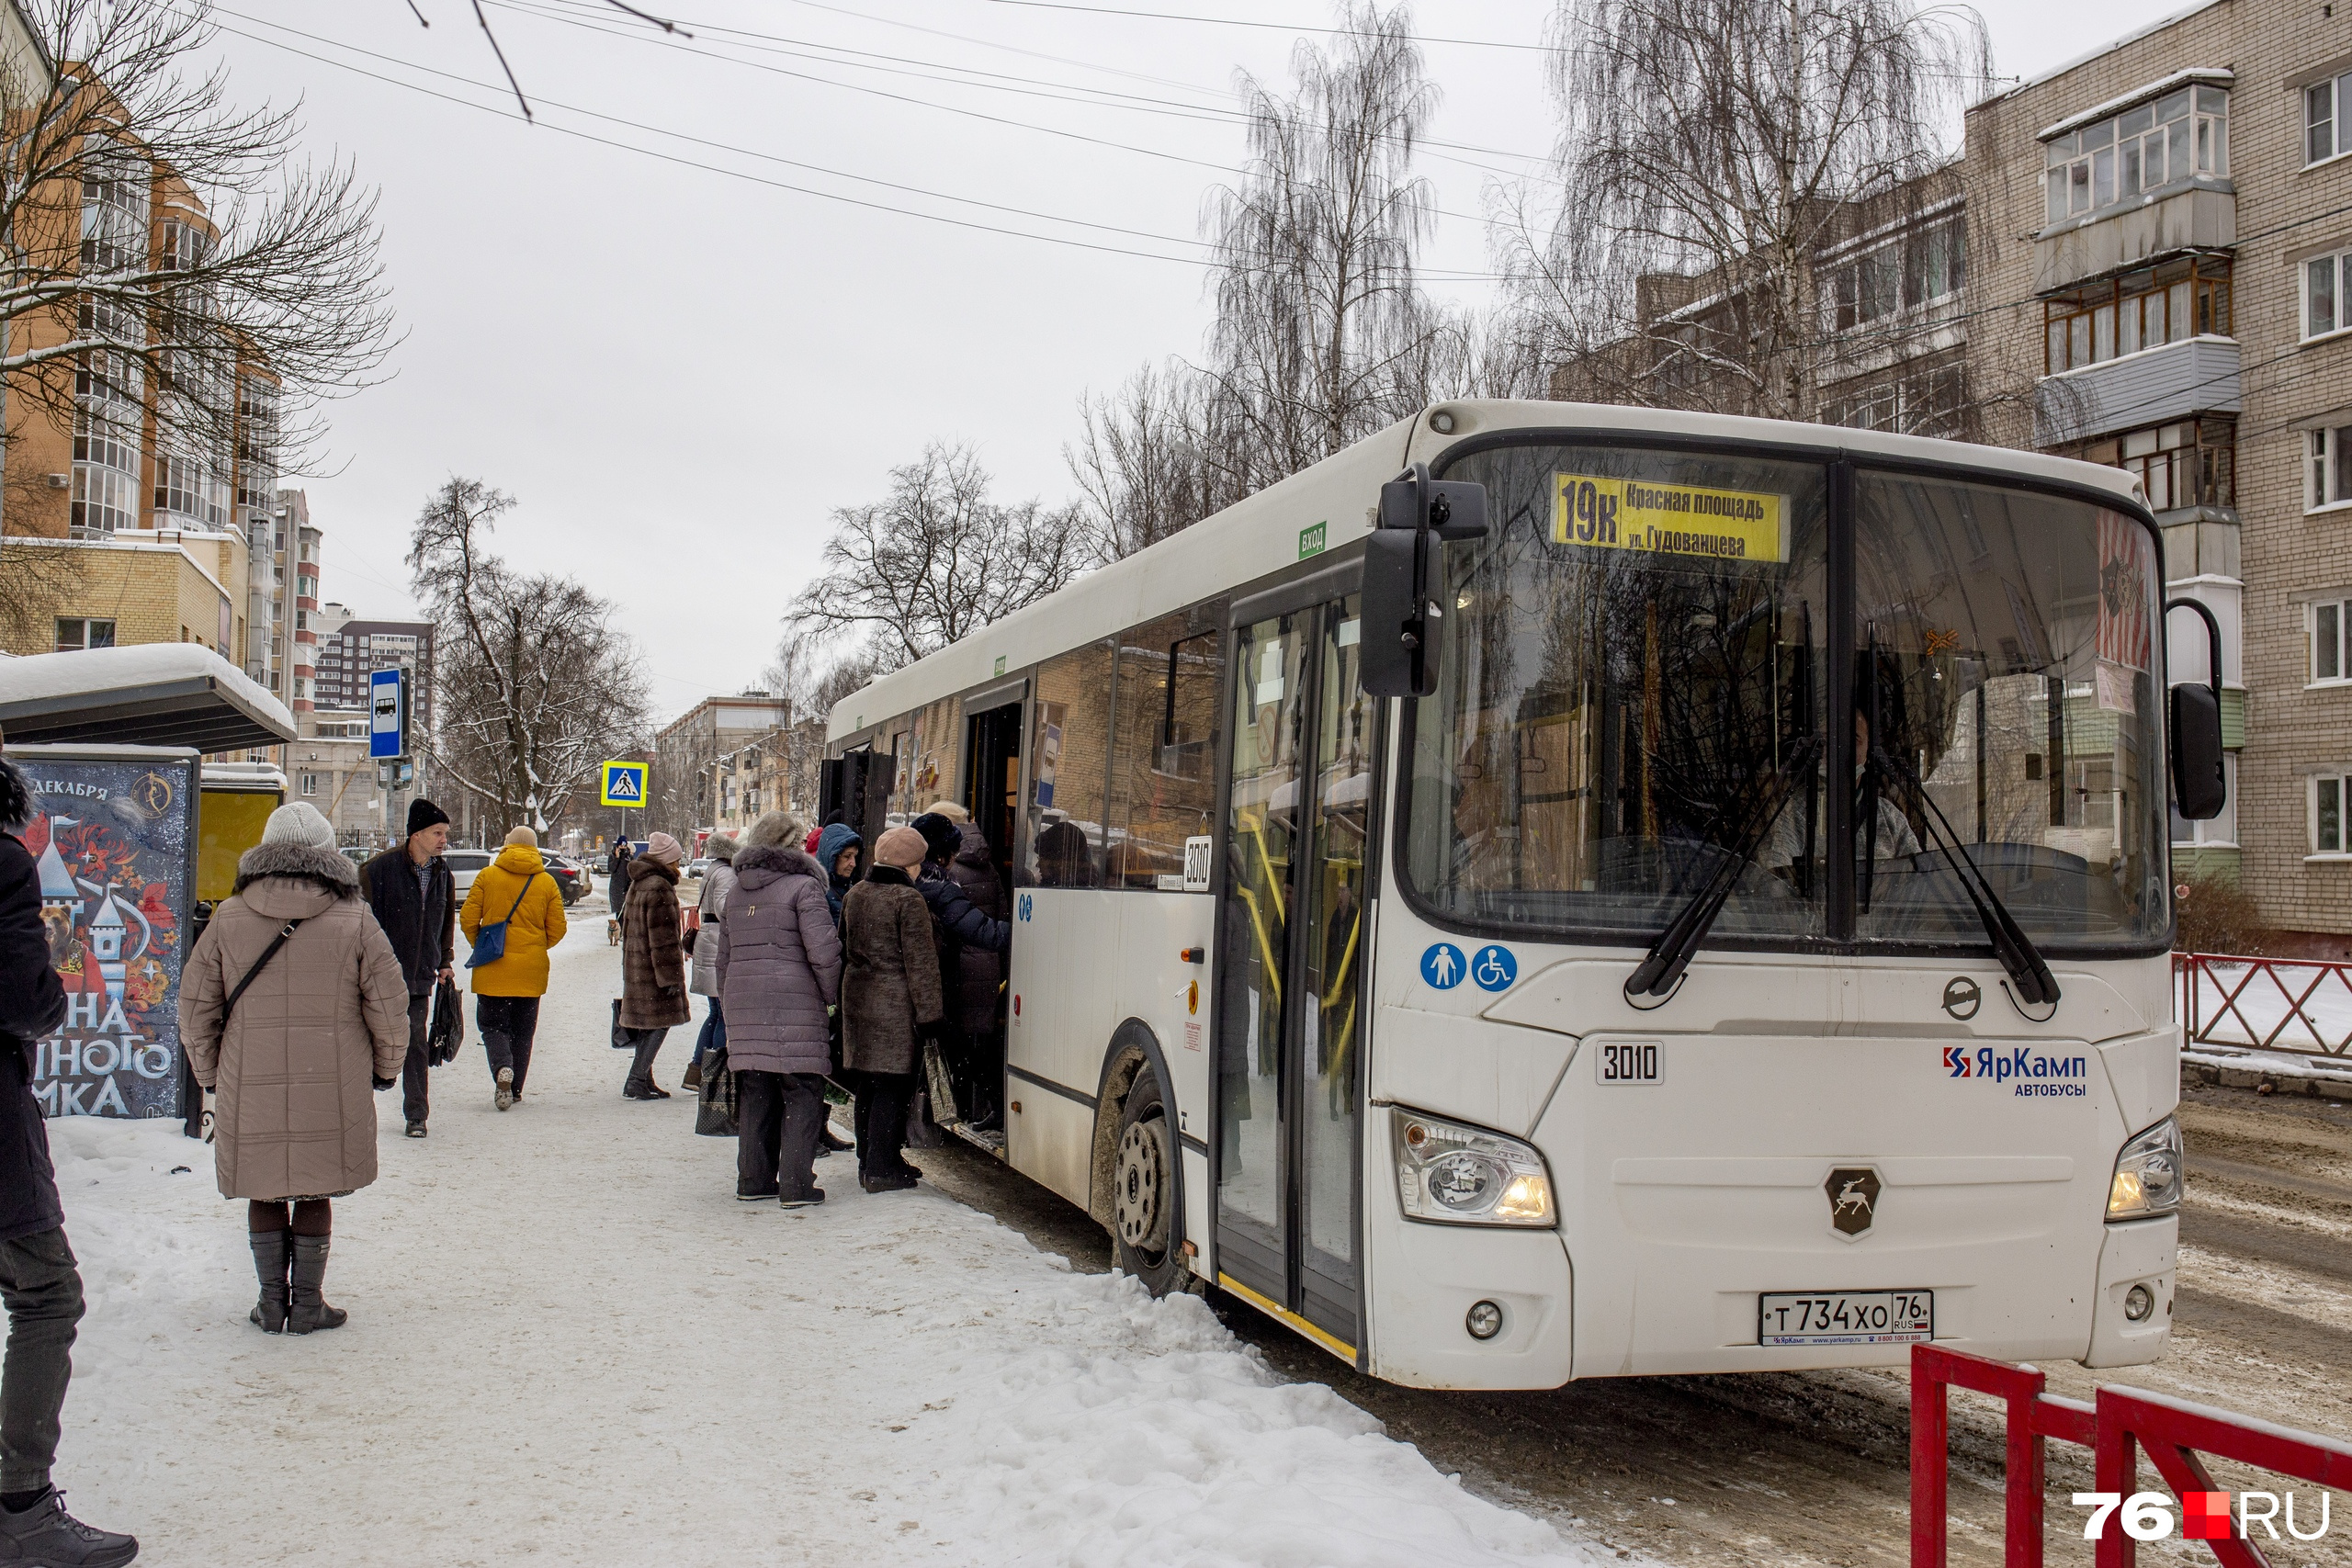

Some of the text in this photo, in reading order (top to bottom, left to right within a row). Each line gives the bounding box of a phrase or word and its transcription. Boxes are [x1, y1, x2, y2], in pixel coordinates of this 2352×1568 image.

[1626, 482, 1765, 523] Красная площадь
[1302, 526, 1324, 553] ВХОД
[1629, 525, 1746, 558] ул. Гудованцева
[33, 780, 108, 801] ДЕКАБРЯ
[1186, 842, 1209, 884] 3010
[55, 992, 133, 1036] НА
[1604, 1045, 1657, 1080] 3010
[1975, 1047, 2086, 1084] ЯрКамп
[31, 1074, 130, 1118] МКА
[2014, 1084, 2086, 1097] АВТОБУСЫ
[1895, 1295, 1922, 1320] 76
[1894, 1320, 1914, 1330] RUS
[1781, 1337, 1805, 1345] ЯрКамп
[1812, 1336, 1861, 1345] www.yarkamp.ru
